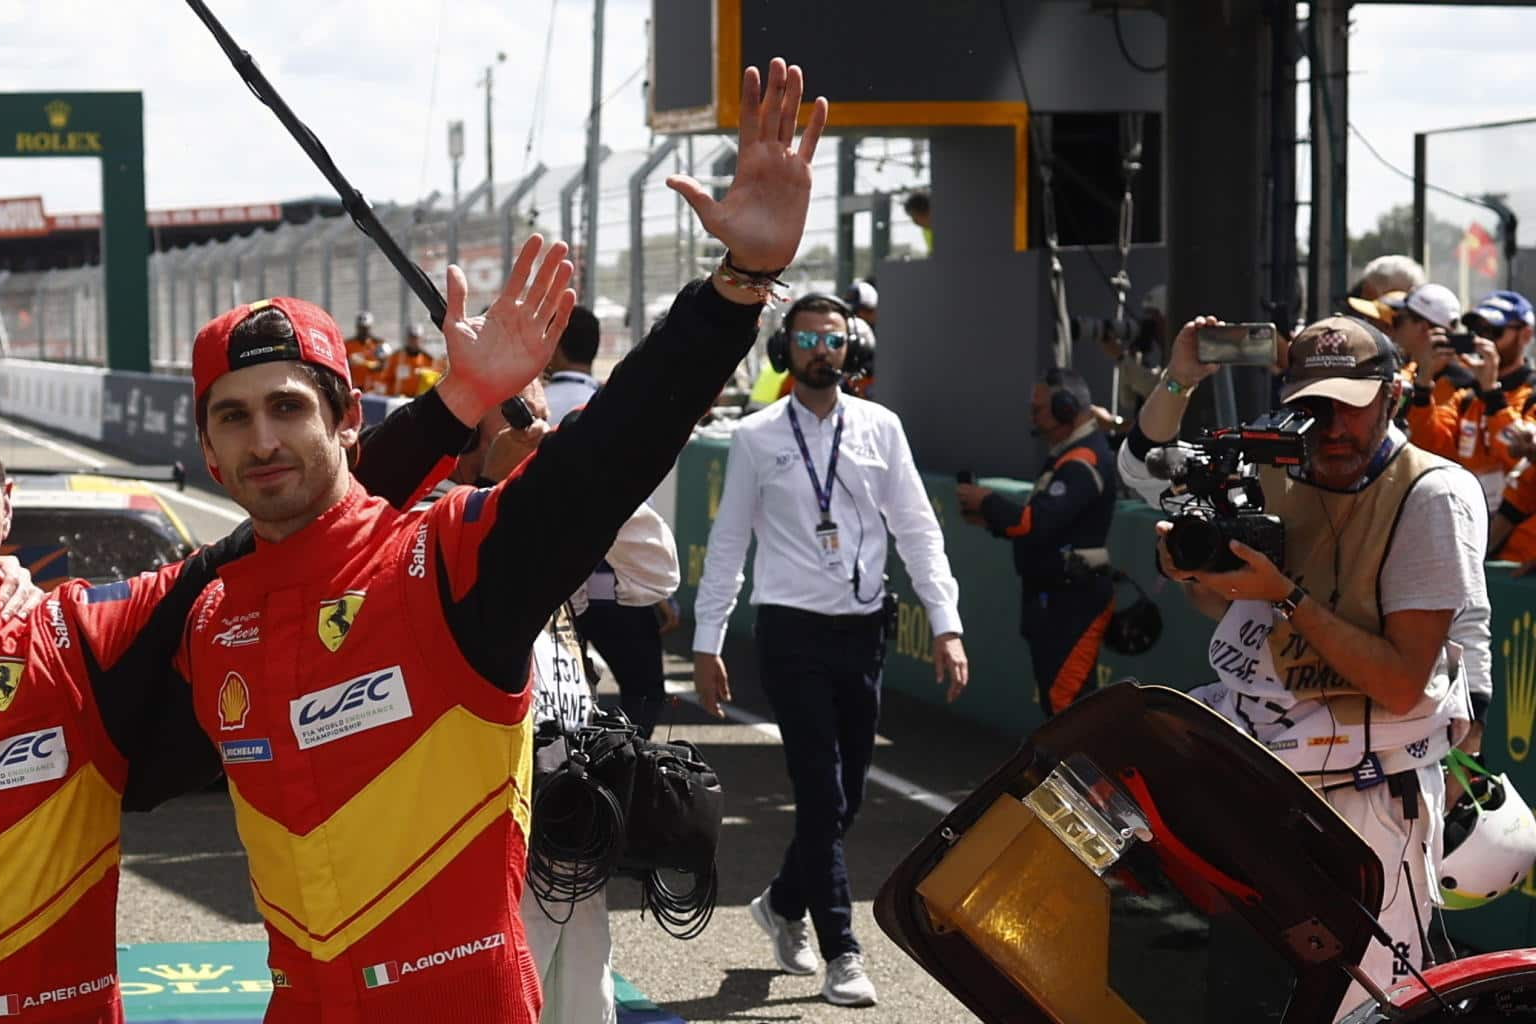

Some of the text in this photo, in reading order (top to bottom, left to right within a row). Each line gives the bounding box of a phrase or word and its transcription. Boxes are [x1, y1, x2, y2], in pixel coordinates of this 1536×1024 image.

[16, 131, 102, 151] ROLEX
[408, 523, 429, 578] Sabelt
[299, 672, 394, 726] WEC
[302, 704, 394, 739] FIA WORLD ENDURANCE
[304, 721, 362, 745] CHAMPIONSHIP
[8, 761, 56, 777] ENDURANCE
[400, 932, 505, 975] A.GIOVINAZZI
[23, 985, 77, 1009] A.PIER
